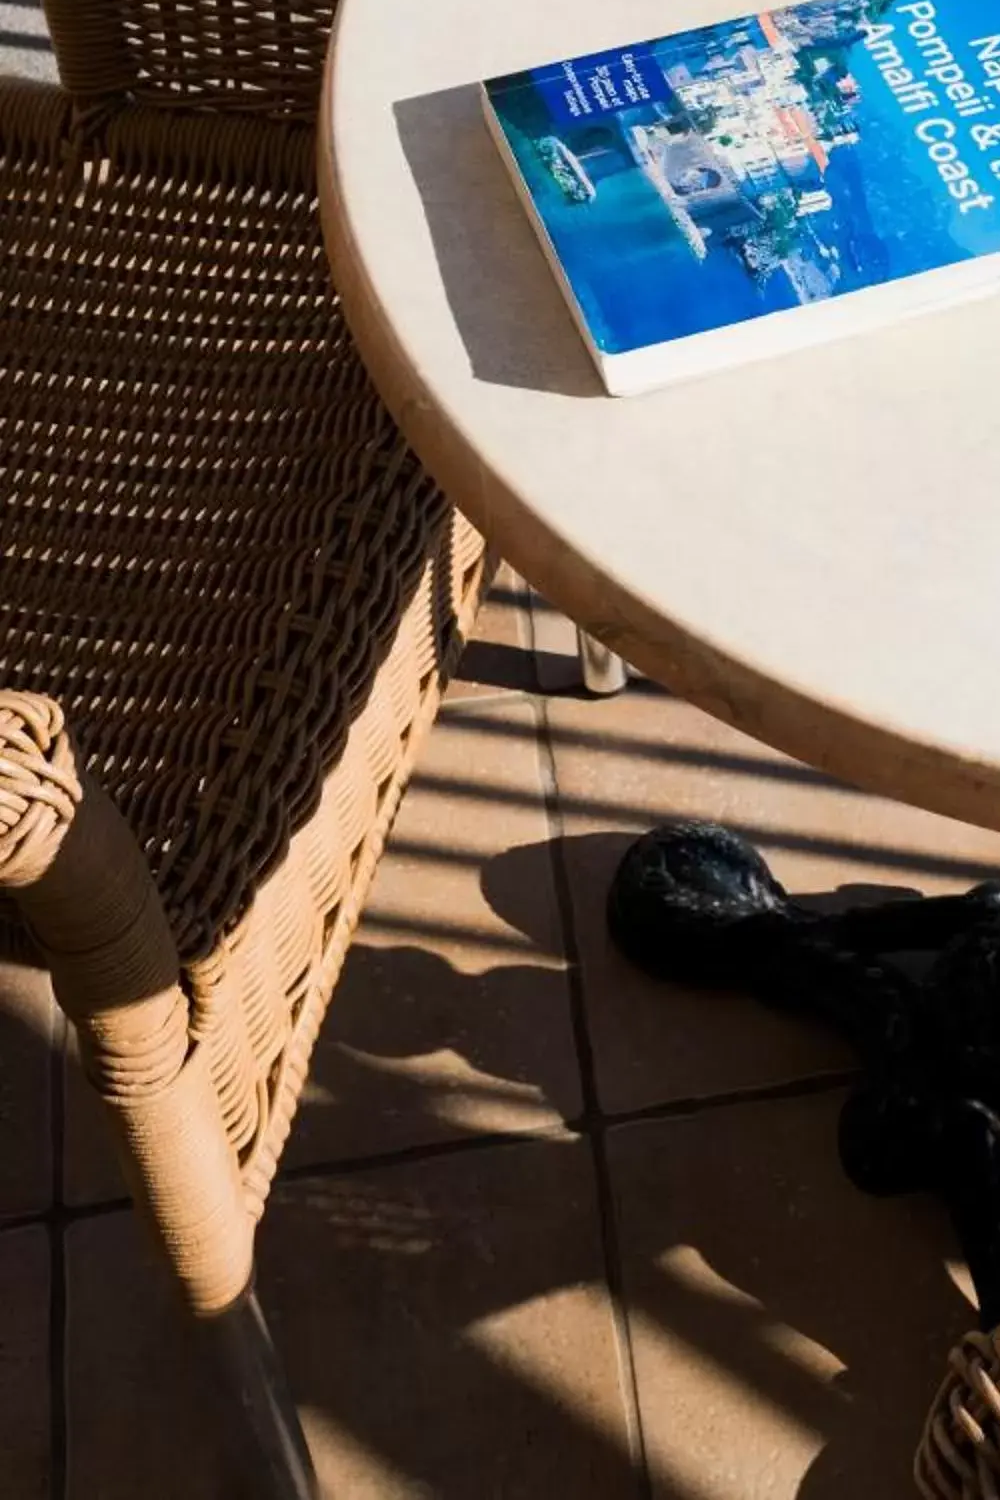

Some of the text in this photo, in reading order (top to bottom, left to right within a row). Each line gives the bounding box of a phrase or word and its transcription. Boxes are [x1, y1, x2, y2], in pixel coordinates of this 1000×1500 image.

[862, 21, 995, 214] Amalfi Coast
[895, 0, 987, 117] Pompeii
